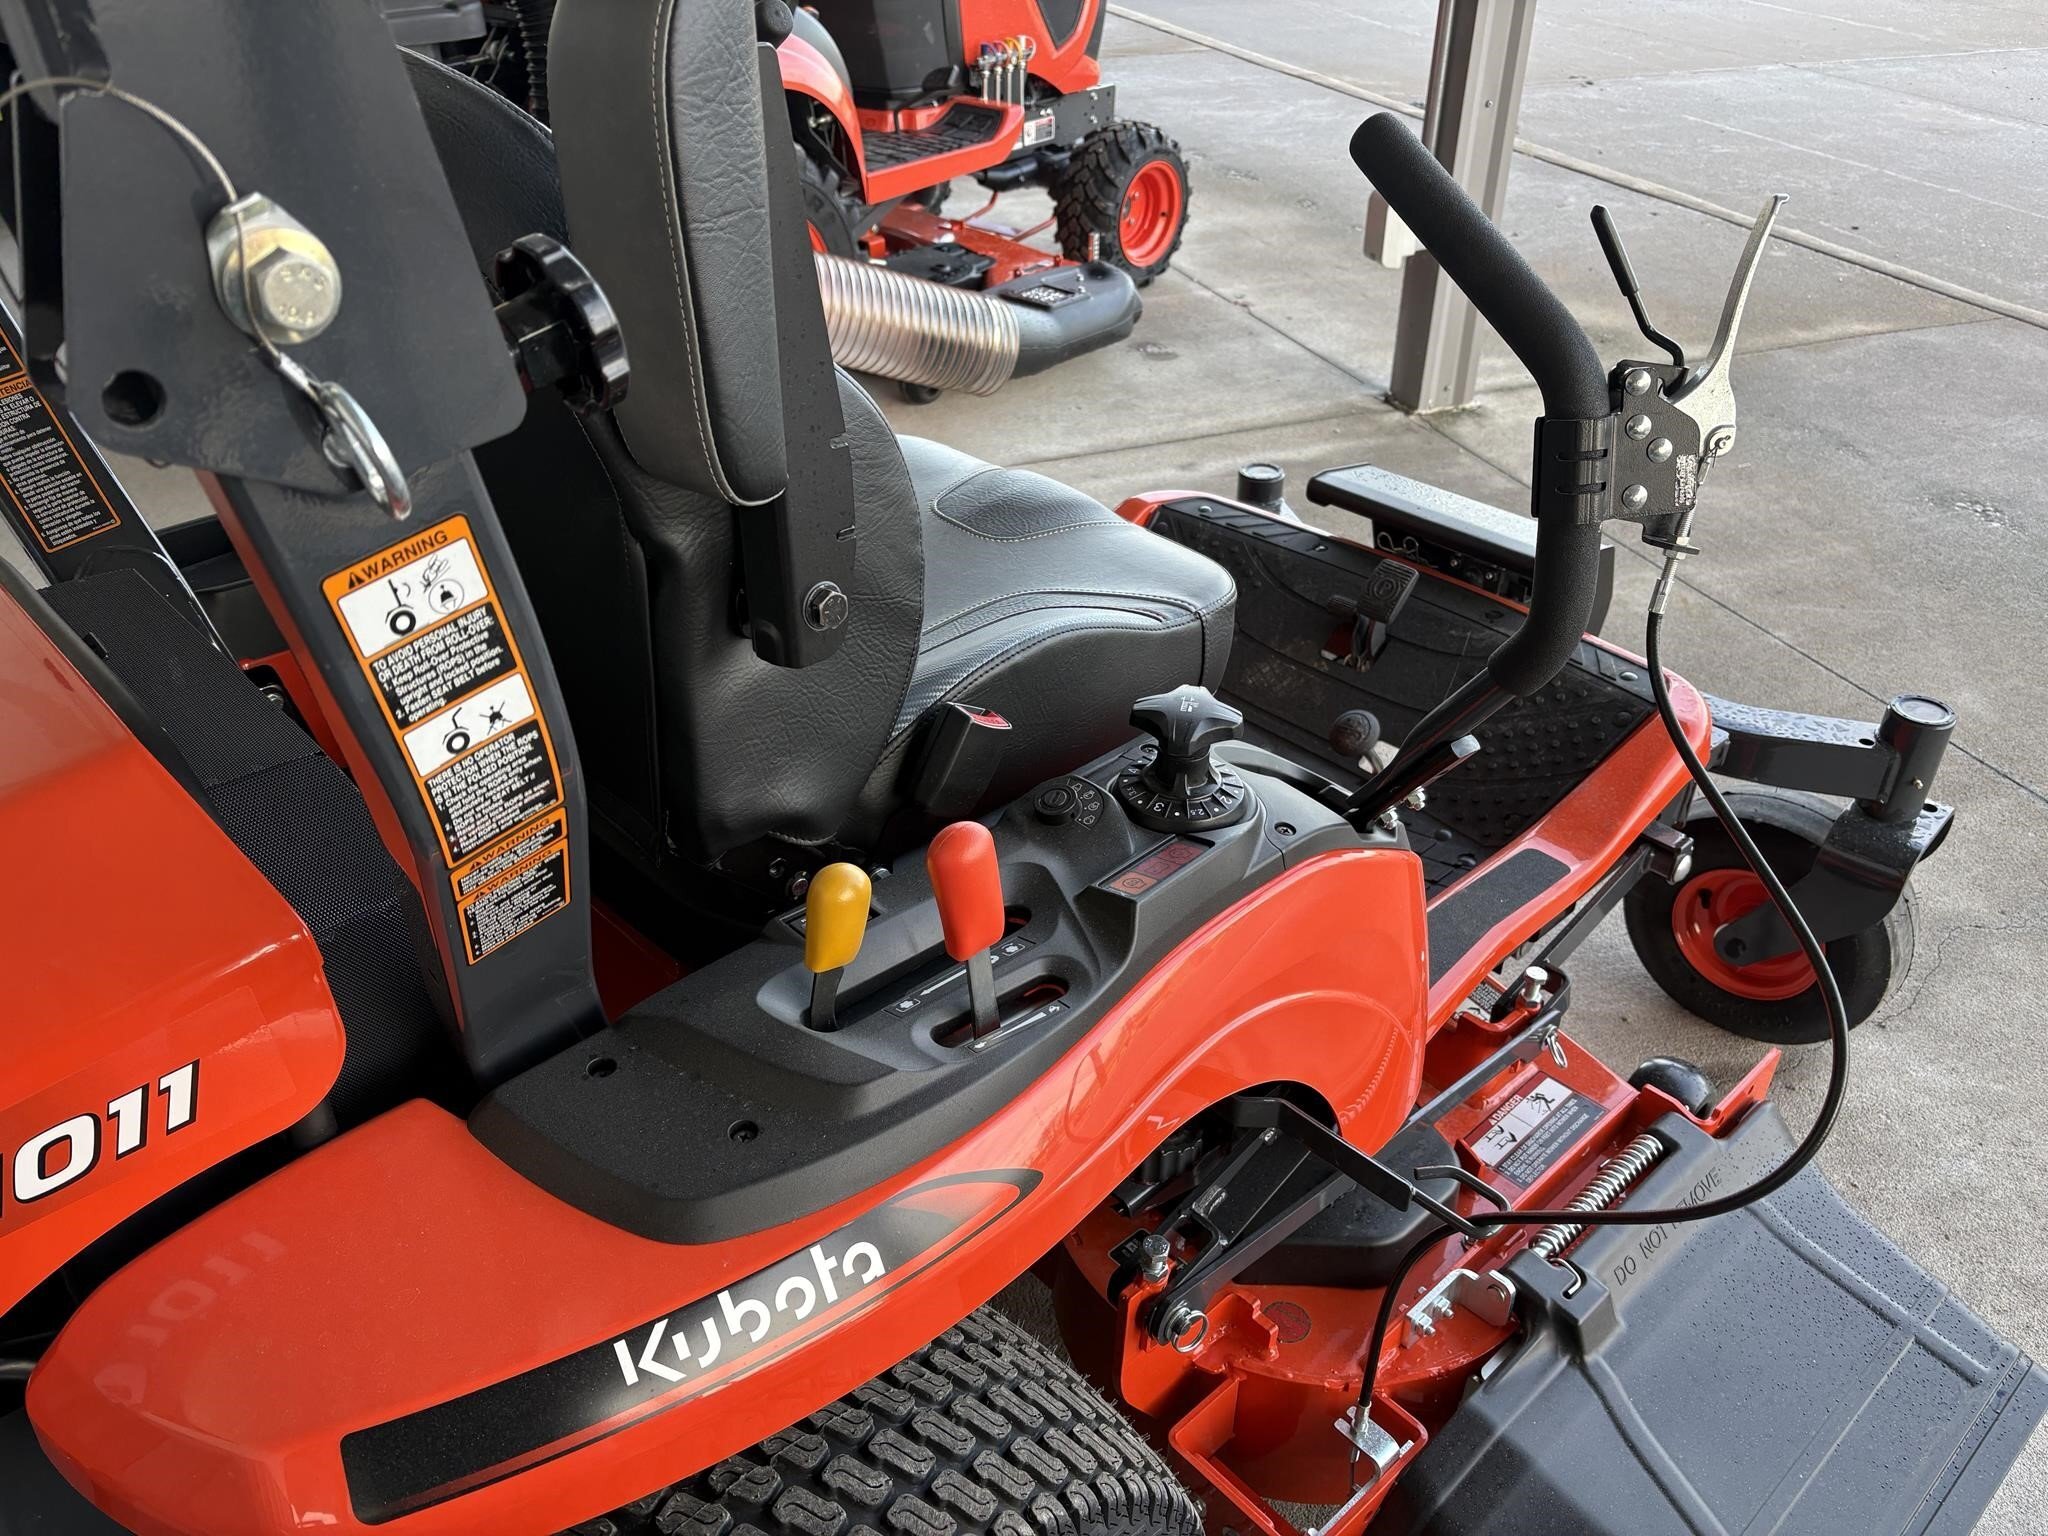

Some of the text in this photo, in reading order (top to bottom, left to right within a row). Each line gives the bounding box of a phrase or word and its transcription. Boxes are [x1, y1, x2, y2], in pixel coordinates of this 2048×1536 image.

[362, 529, 448, 580] WARNING
[373, 607, 487, 672] TO AVOID PERSONAL INJURY
[378, 616, 494, 682] OR DEATH FROM ROLL-OVER:
[383, 631, 490, 692] 1. Keep Roll-Over Protective
[395, 643, 487, 696] Structures (ROPS) in the
[395, 657, 501, 719] 2. Fasten SEAT BELT before
[399, 645, 503, 705] upright and locked position.
[408, 697, 448, 723] operating.
[428, 732, 515, 788] THERE IS NO OPERATOR
[431, 730, 538, 797] PROTECTION WHEN THE ROPS
[435, 742, 533, 805] IS IN THE FOLDED POSITION.
[446, 791, 467, 807] Check
[467, 783, 479, 794] the
[479, 765, 511, 787] operating
[512, 756, 526, 768] area
[448, 755, 542, 814] and fold the ROPS only when
[1152, 802, 1165, 812] 3
[1219, 795, 1233, 806] 2
[483, 818, 549, 862] WARNING
[488, 849, 551, 891] WARNING
[1493, 1093, 1522, 1122] DANGER
[0, 1059, 200, 1219] 011
[1612, 1256, 1638, 1286] DO
[613, 1241, 886, 1386] Kubota
